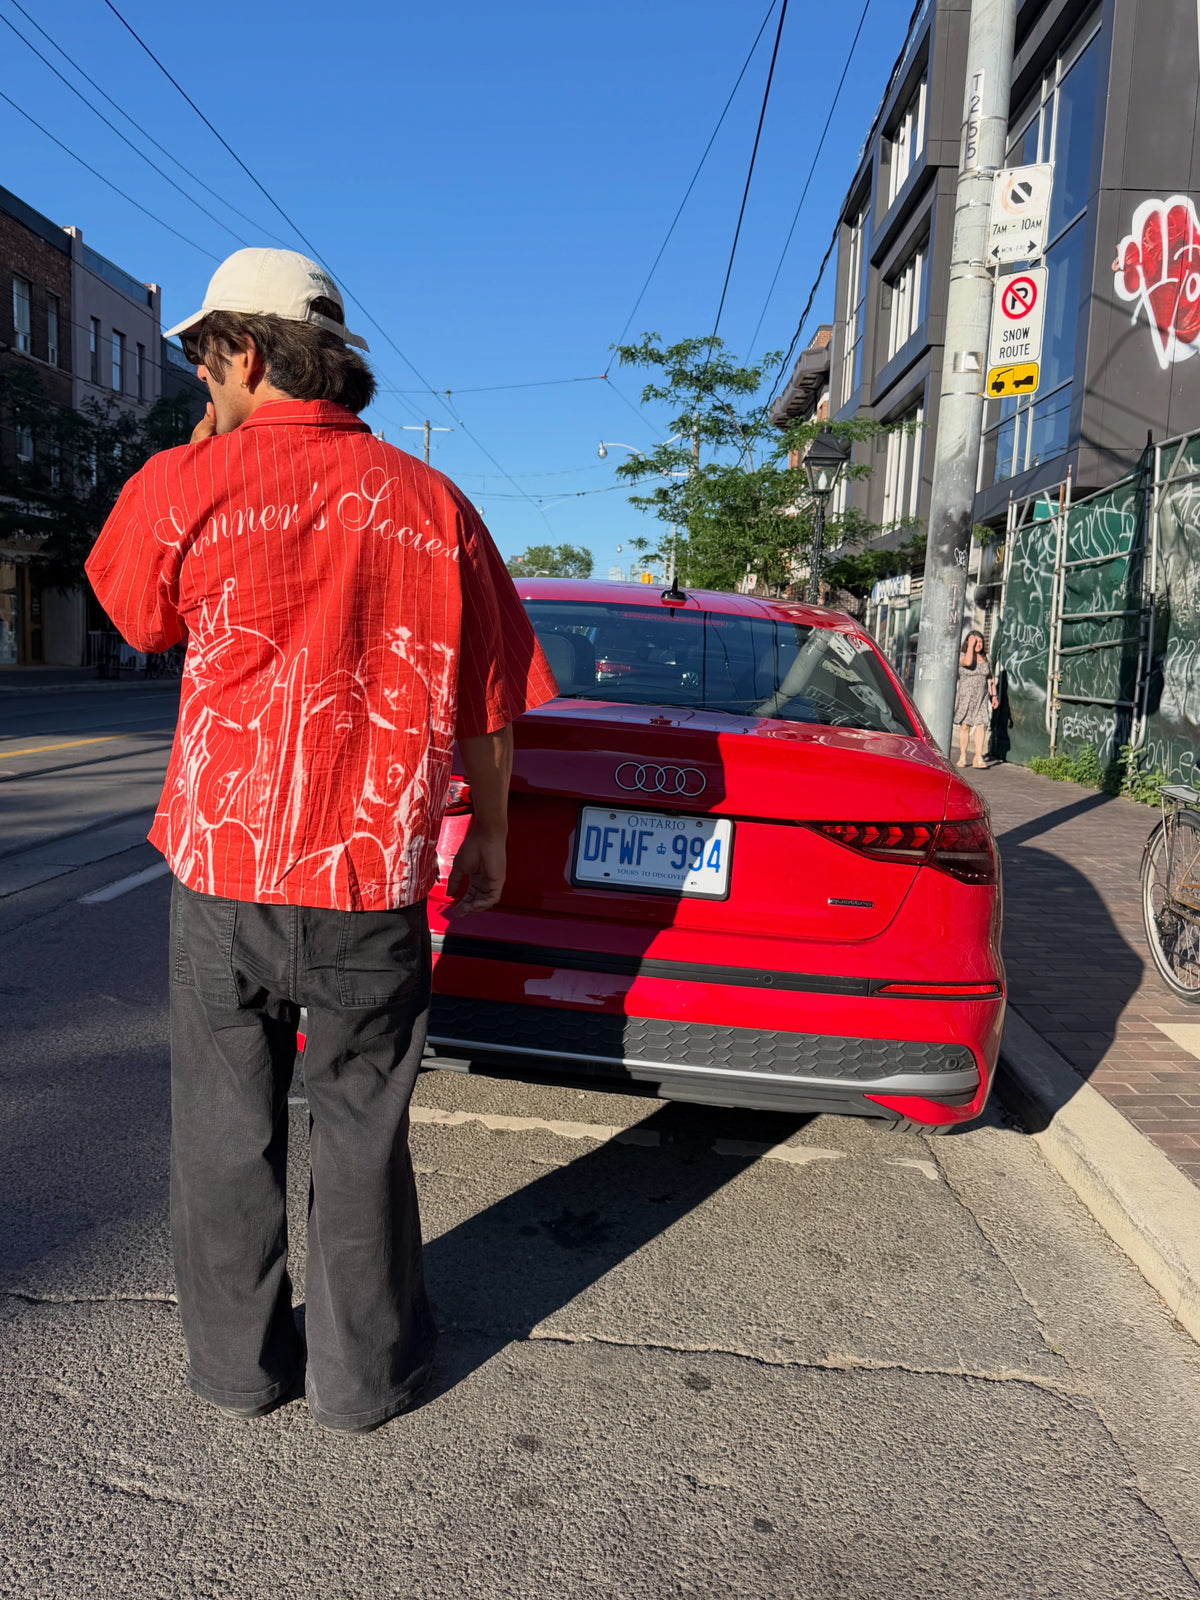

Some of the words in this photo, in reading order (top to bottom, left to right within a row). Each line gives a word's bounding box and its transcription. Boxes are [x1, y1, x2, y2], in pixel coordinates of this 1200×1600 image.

[966, 73, 983, 160] T255
[992, 223, 1009, 236] 7AM
[1021, 218, 1043, 230] 10AM
[1002, 327, 1030, 343] SNOW
[999, 343, 1031, 359] ROUTE
[627, 814, 686, 831] ONTARIO
[583, 825, 655, 866] DFWF
[670, 834, 722, 874] 994
[616, 868, 640, 878] YOURS
[641, 870, 651, 878] TO
